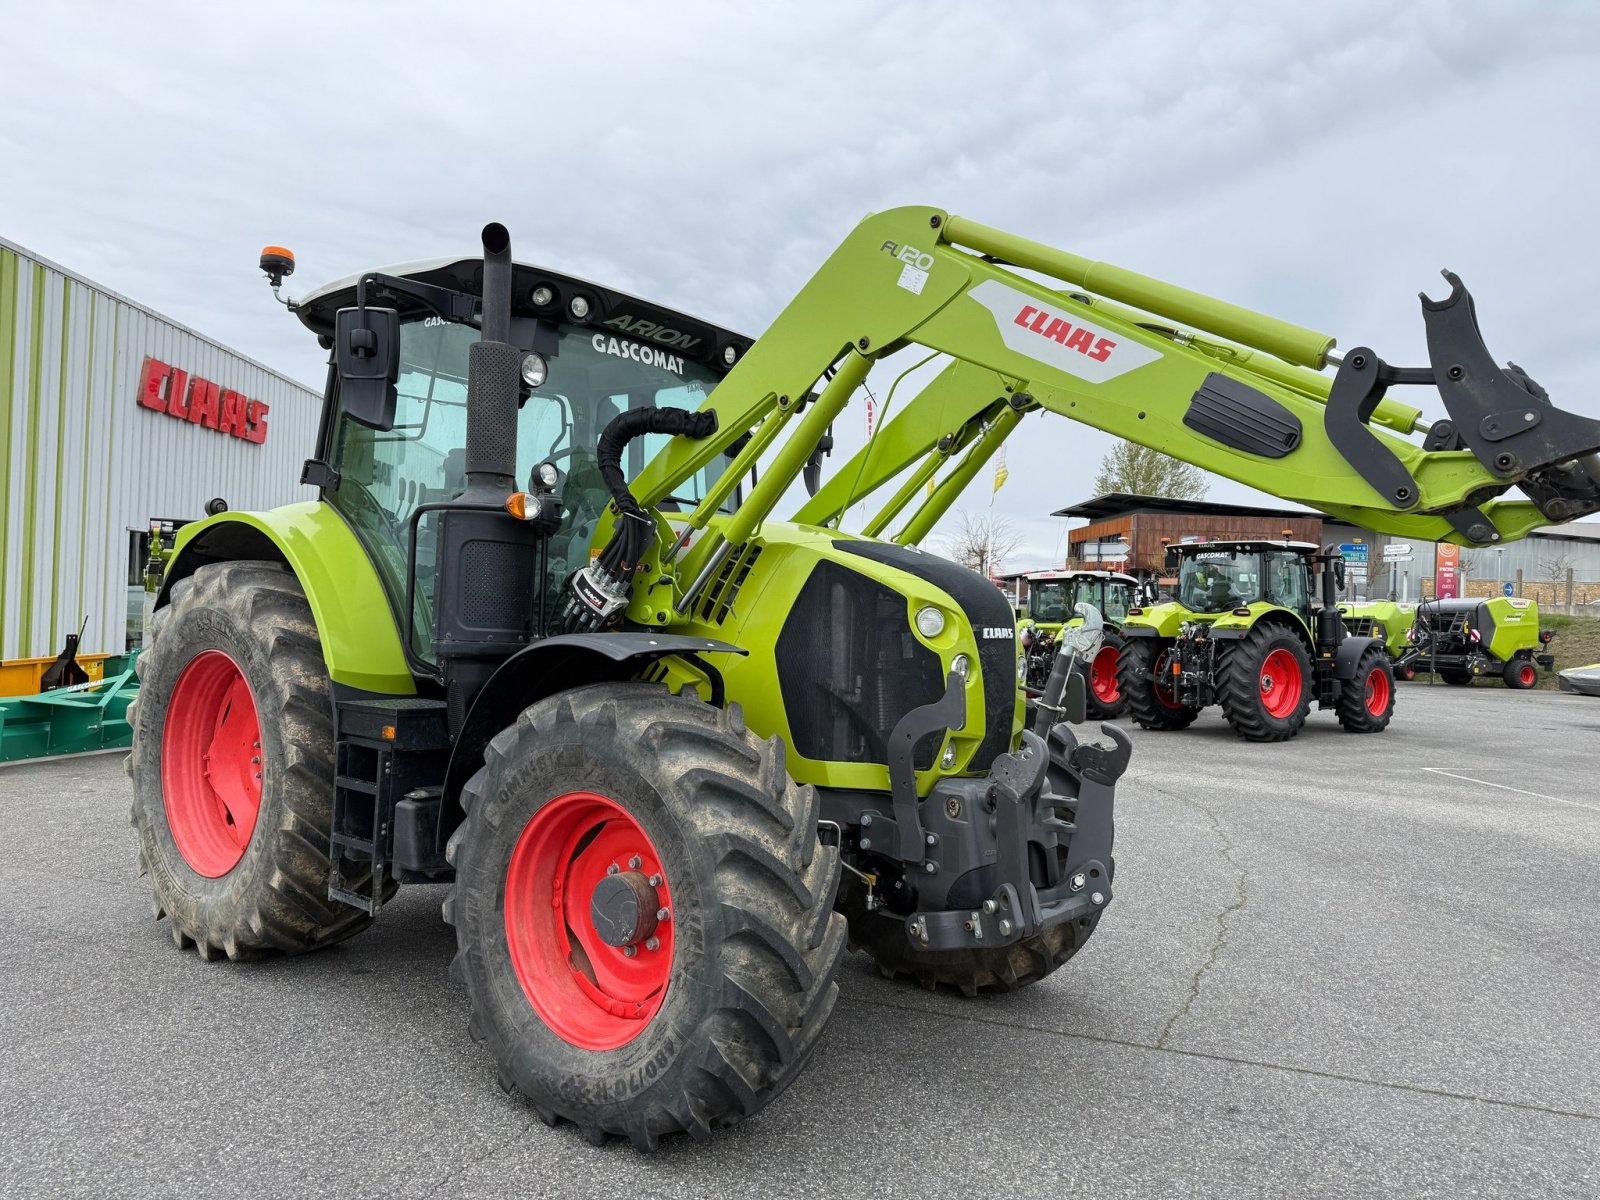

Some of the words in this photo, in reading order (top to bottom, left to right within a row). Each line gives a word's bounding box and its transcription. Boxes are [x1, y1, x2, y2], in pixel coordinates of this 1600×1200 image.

[603, 314, 702, 349] ARION
[1014, 305, 1117, 363] CLAAS
[591, 333, 684, 375] GASCOMAT
[137, 355, 270, 445] CLAAS
[1196, 552, 1229, 560] GASCOMAT
[982, 627, 1014, 639] CLAAS
